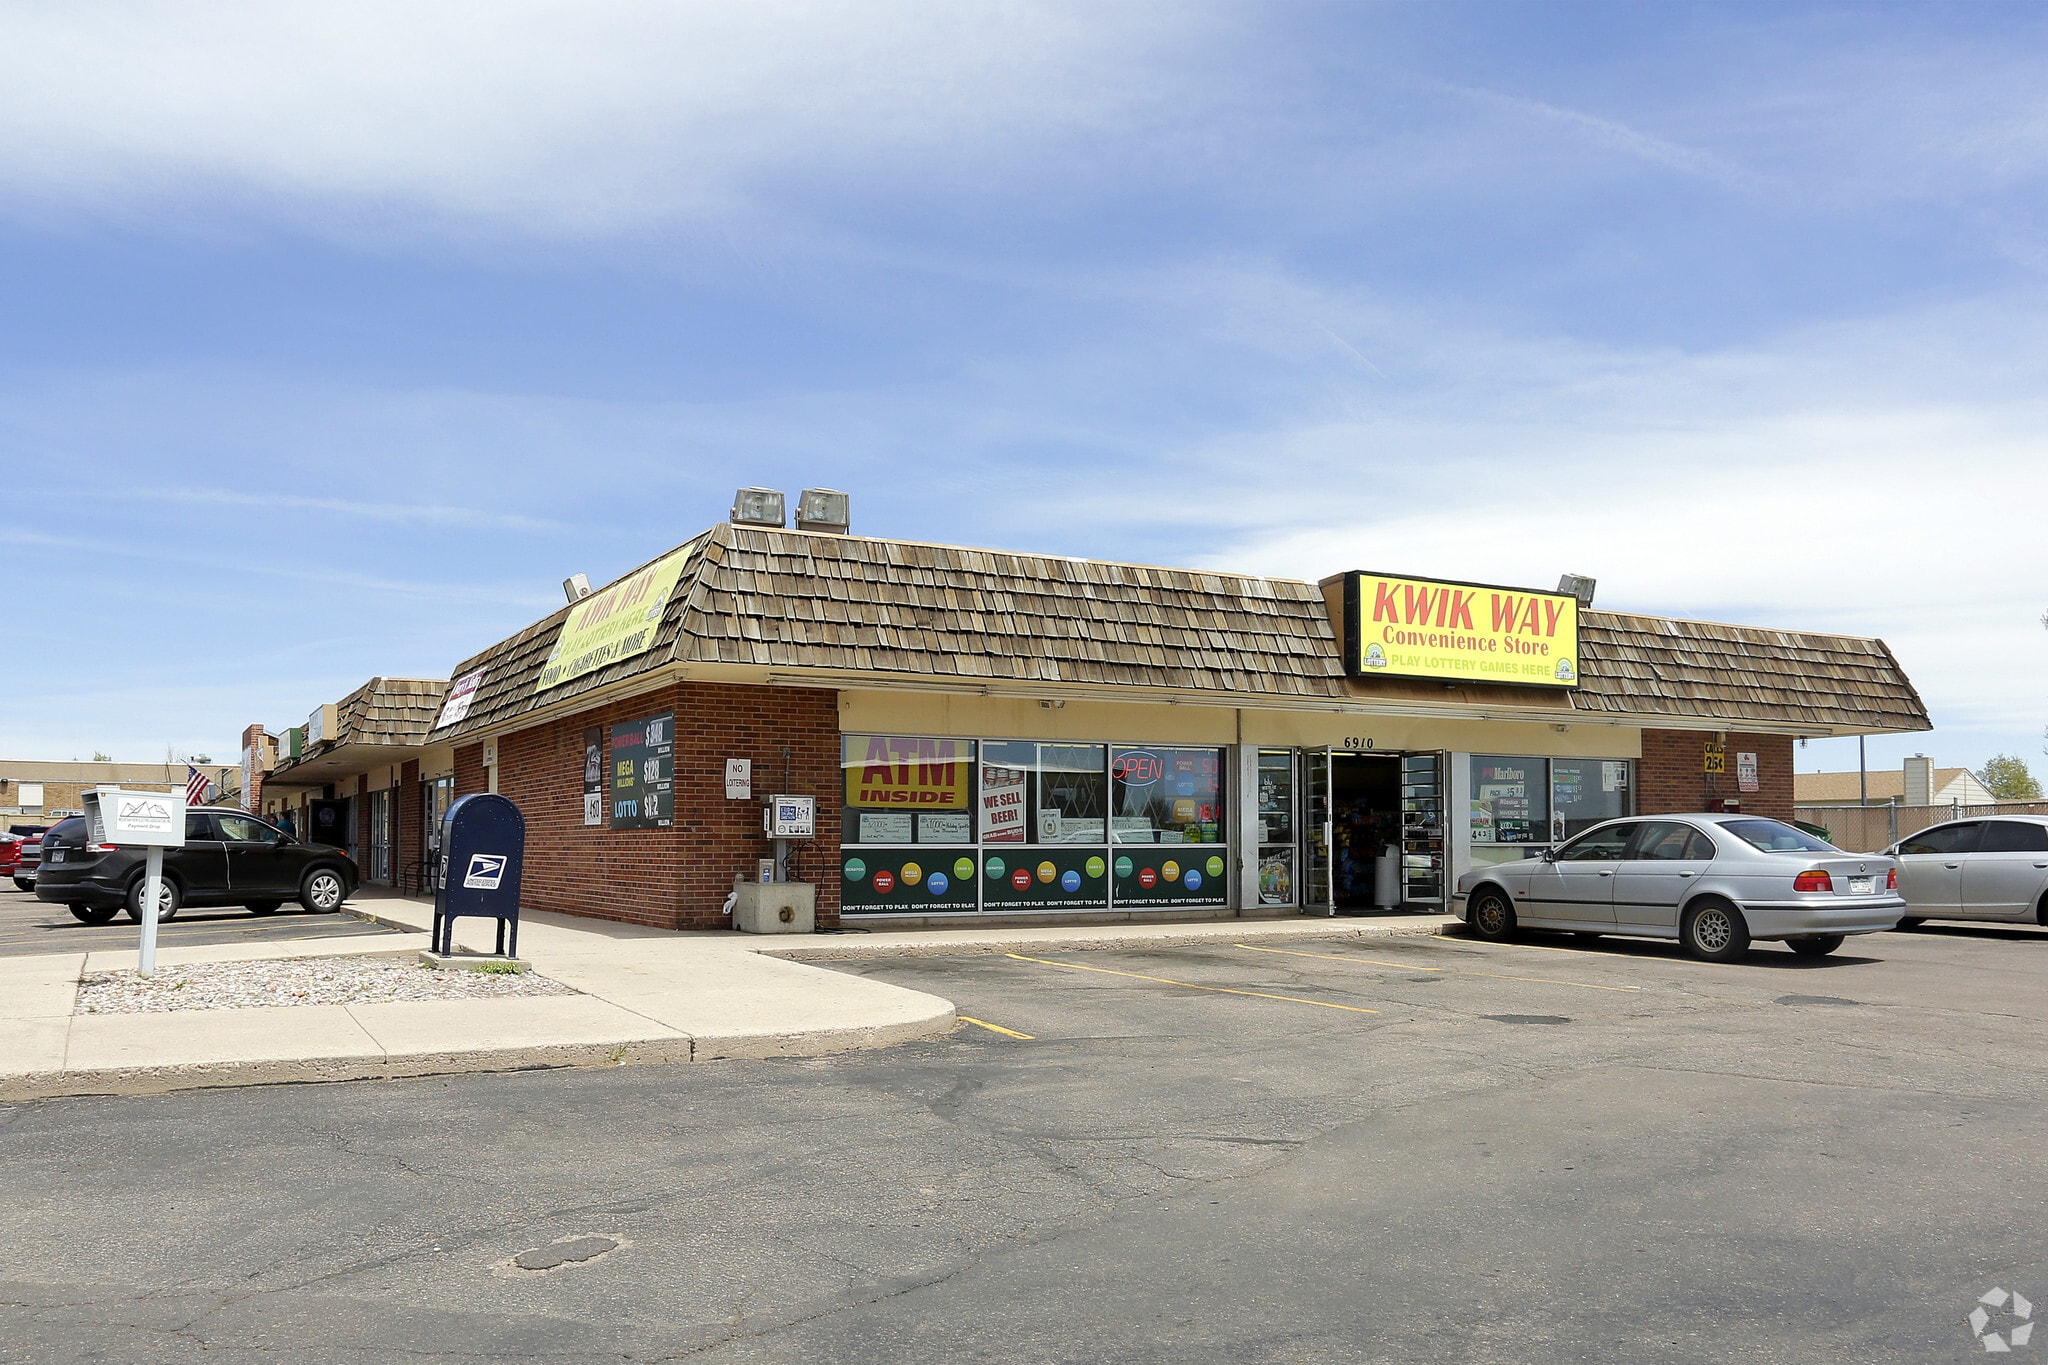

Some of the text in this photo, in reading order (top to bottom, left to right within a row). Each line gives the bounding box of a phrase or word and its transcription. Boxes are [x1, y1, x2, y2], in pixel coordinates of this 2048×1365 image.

[616, 566, 659, 613] WAY
[1373, 582, 1564, 637] KWIK WAY
[621, 628, 649, 656] MORE
[1383, 626, 1549, 656] Convenience Store
[1364, 657, 1386, 667] LOTTERY
[1391, 654, 1550, 675] PLAY LOTTERY GAMES HERE
[611, 732, 644, 748] POWERBALL
[1344, 737, 1373, 748] 6910
[617, 760, 634, 776] MEGA
[732, 764, 742, 773] NO
[862, 737, 955, 786] ATM
[1112, 758, 1164, 779] OPEN
[1493, 768, 1524, 780] Marlboro
[726, 778, 749, 787] LOITERING
[860, 790, 955, 803] INSIDE
[984, 792, 1022, 809] WE SELL
[615, 800, 638, 818] LOTTO
[991, 809, 1018, 825] BEER!
